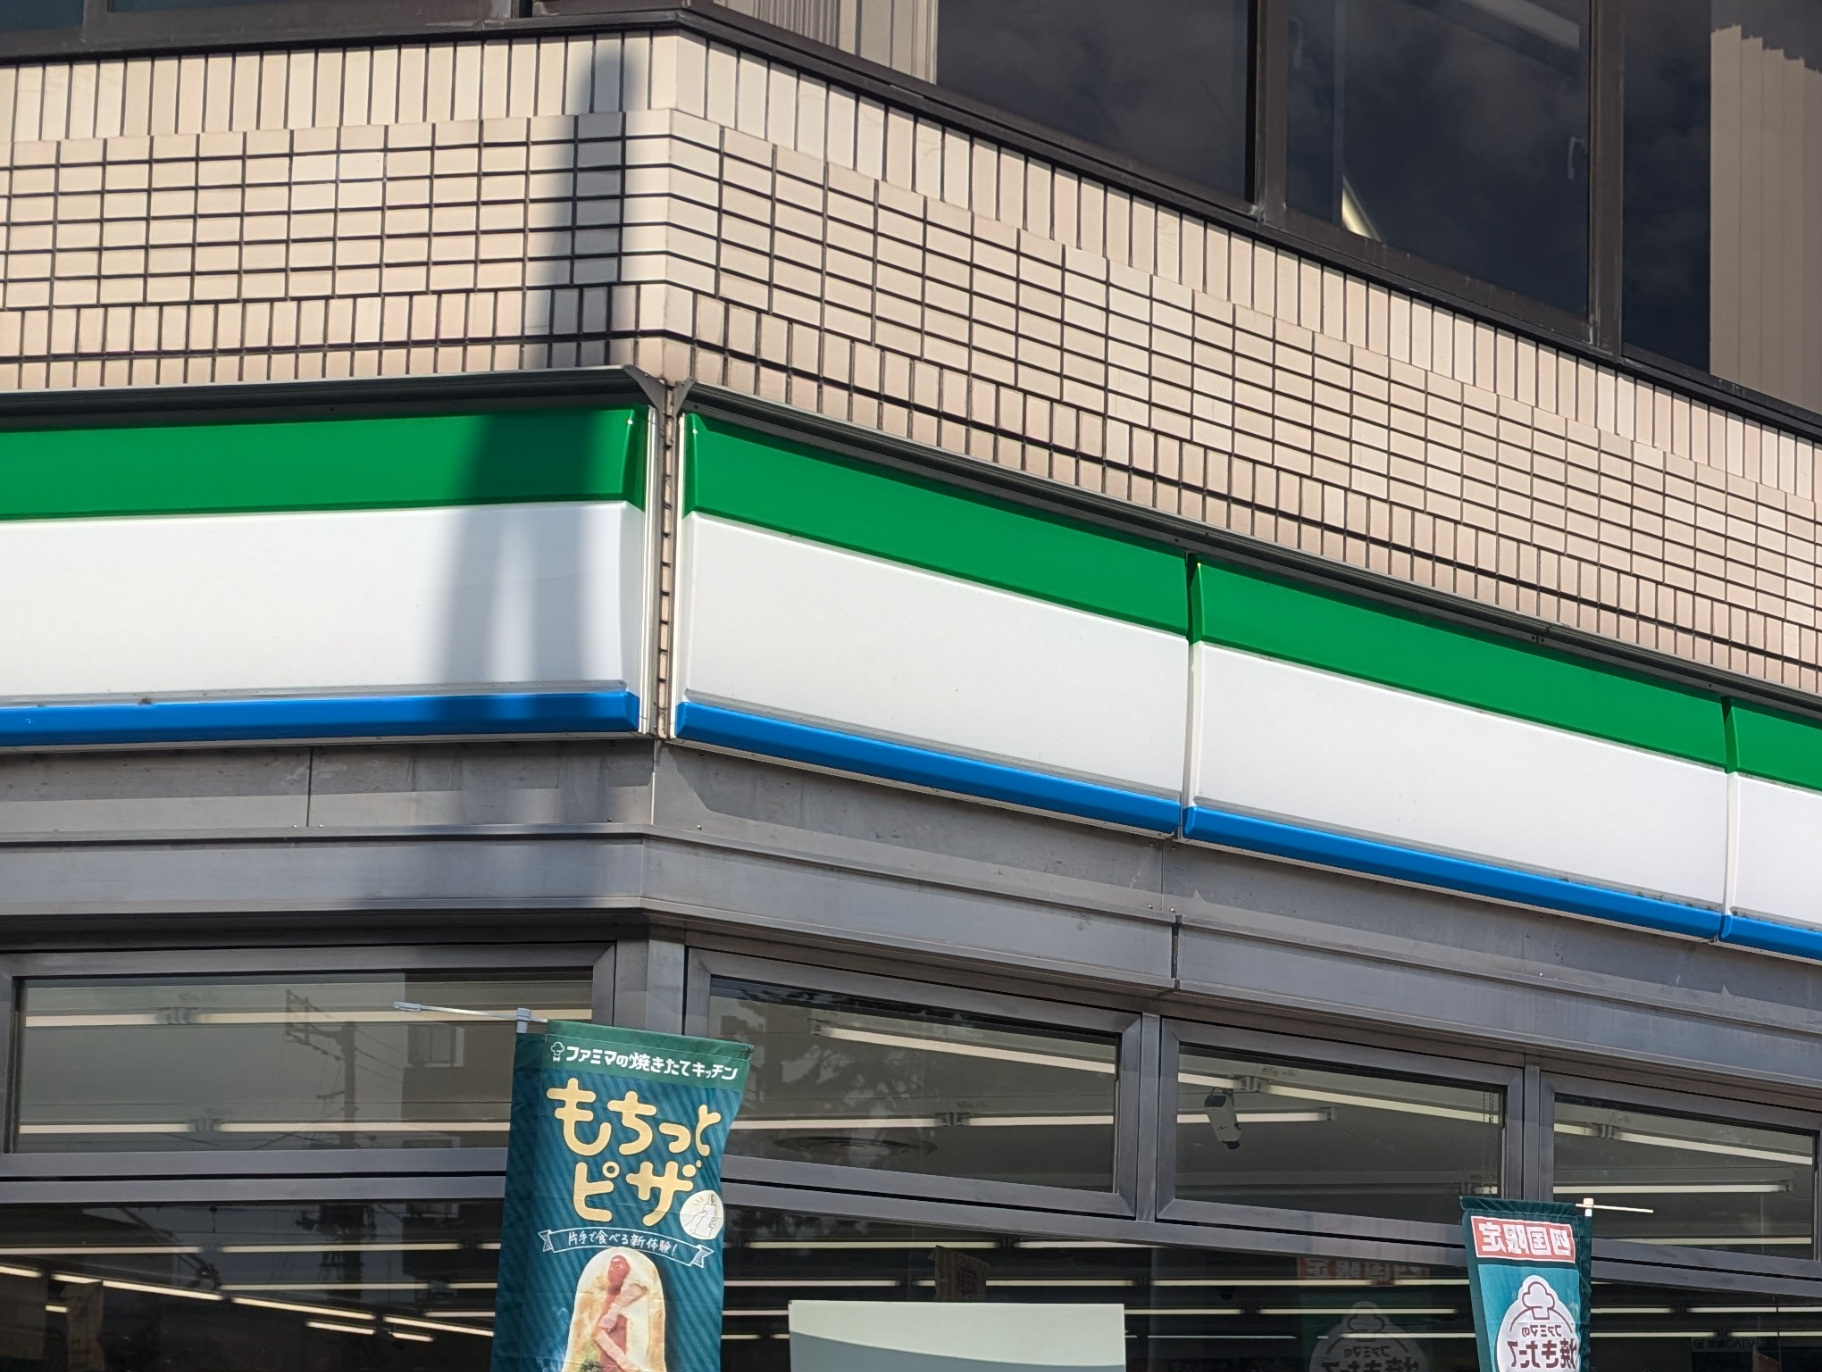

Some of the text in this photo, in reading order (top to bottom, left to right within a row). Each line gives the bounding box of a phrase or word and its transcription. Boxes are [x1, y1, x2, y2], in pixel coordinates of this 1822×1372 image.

[566, 1045, 737, 1081] ファミマの焼きたてキッチン
[546, 1077, 722, 1157] もちっと
[572, 1158, 702, 1227] ピザ
[567, 1229, 678, 1257] 片手で食べる新体験!
